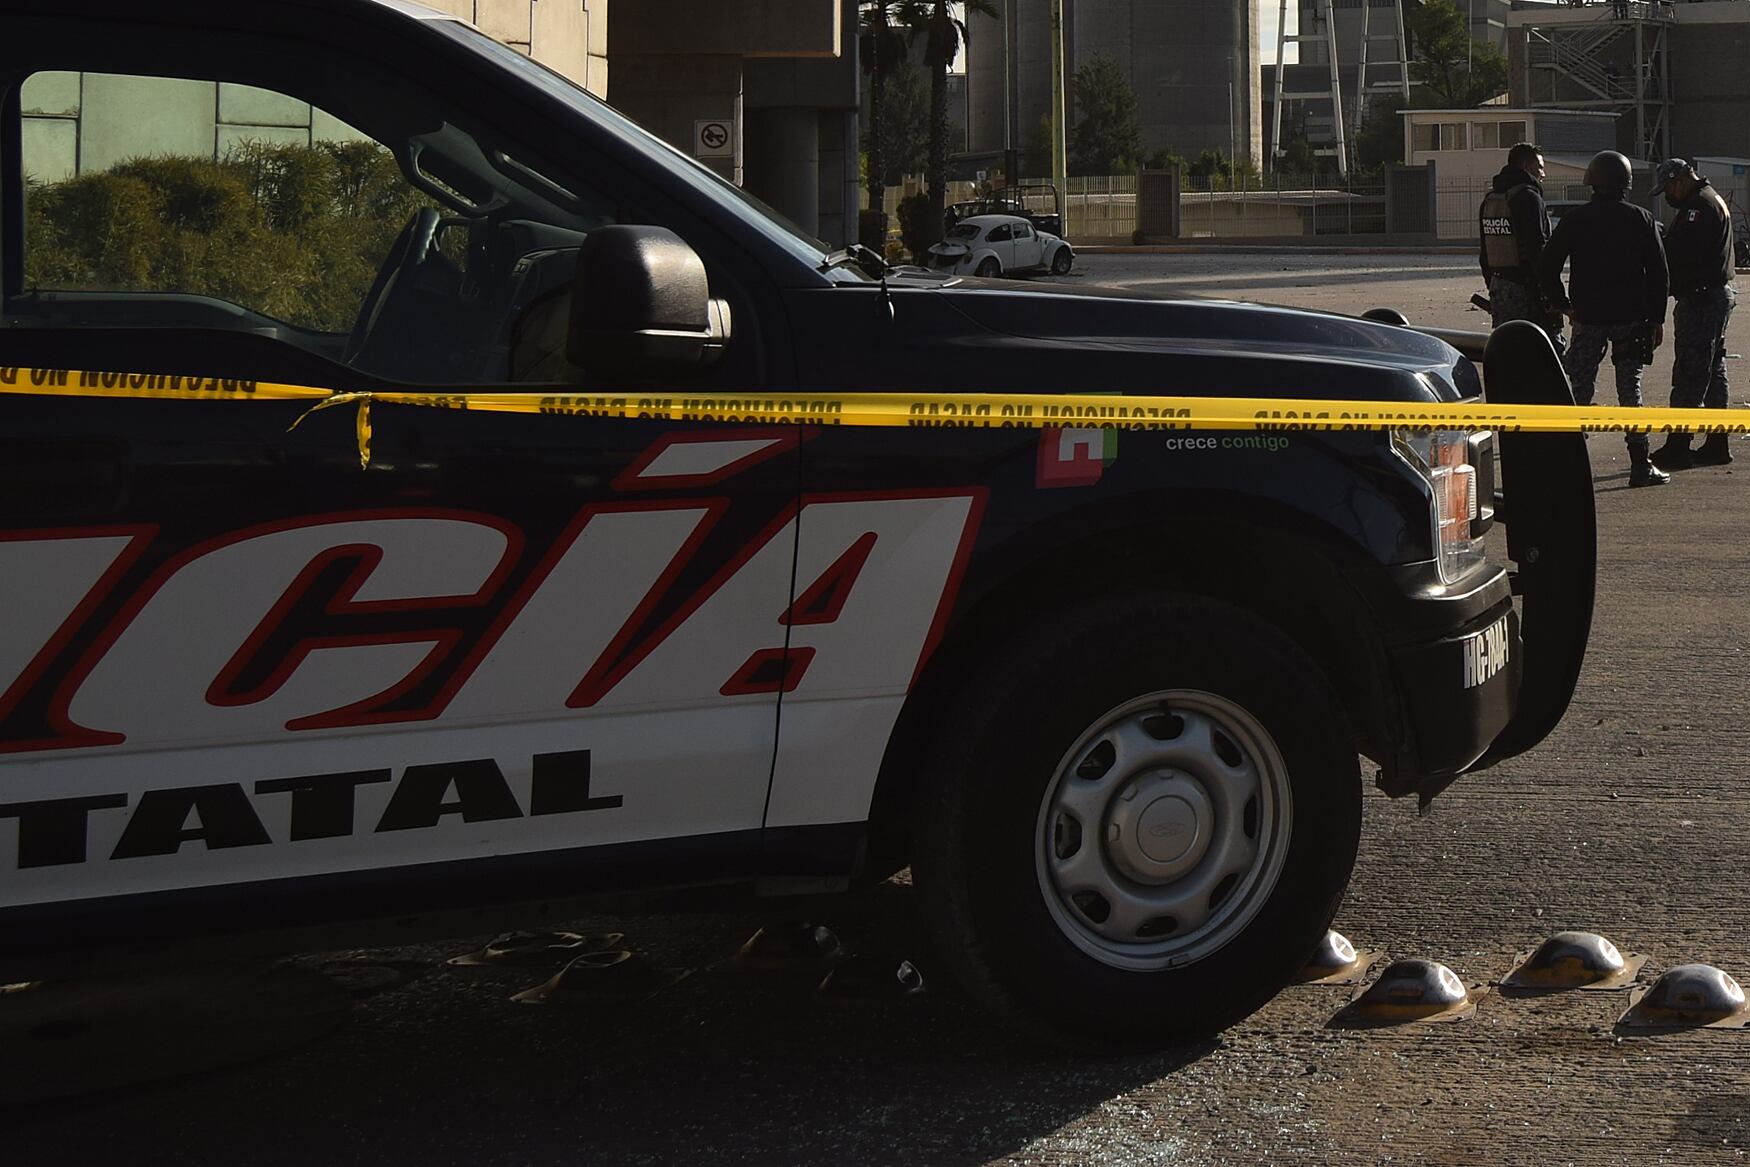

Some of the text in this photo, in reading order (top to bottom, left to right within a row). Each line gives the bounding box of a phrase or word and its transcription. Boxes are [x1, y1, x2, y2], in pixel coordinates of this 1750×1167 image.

[1165, 433, 1289, 452] crece contigo
[0, 749, 624, 870] TATAL
